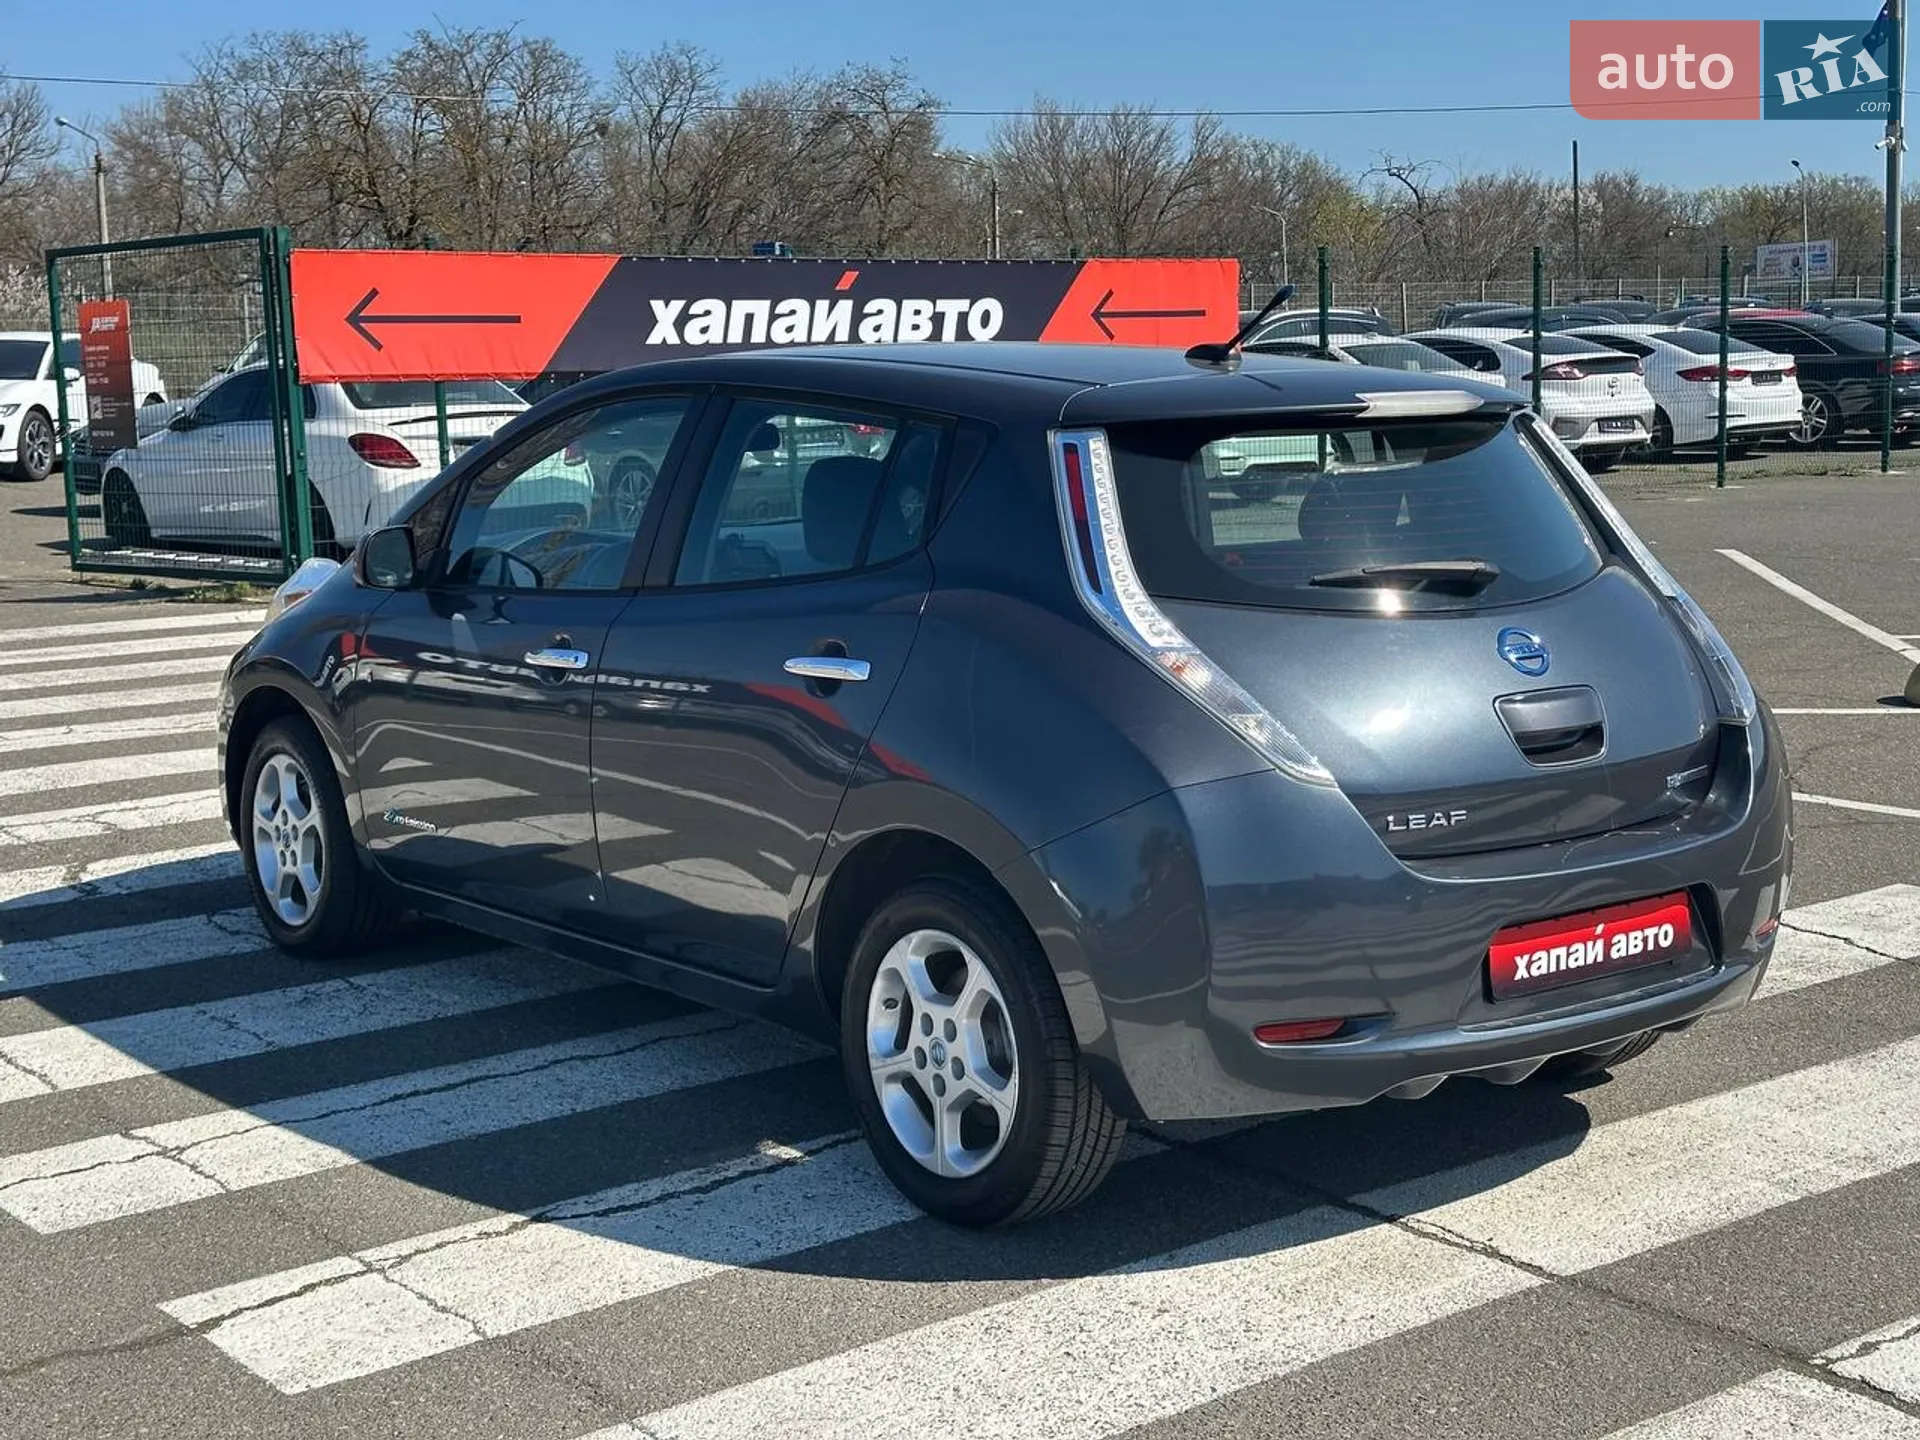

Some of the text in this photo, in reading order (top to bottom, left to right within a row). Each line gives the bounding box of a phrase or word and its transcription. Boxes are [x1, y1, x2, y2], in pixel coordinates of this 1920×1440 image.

[645, 270, 1004, 345] хапай авто
[1387, 809, 1467, 831] LEAF
[1513, 922, 1675, 981] хапай авто
